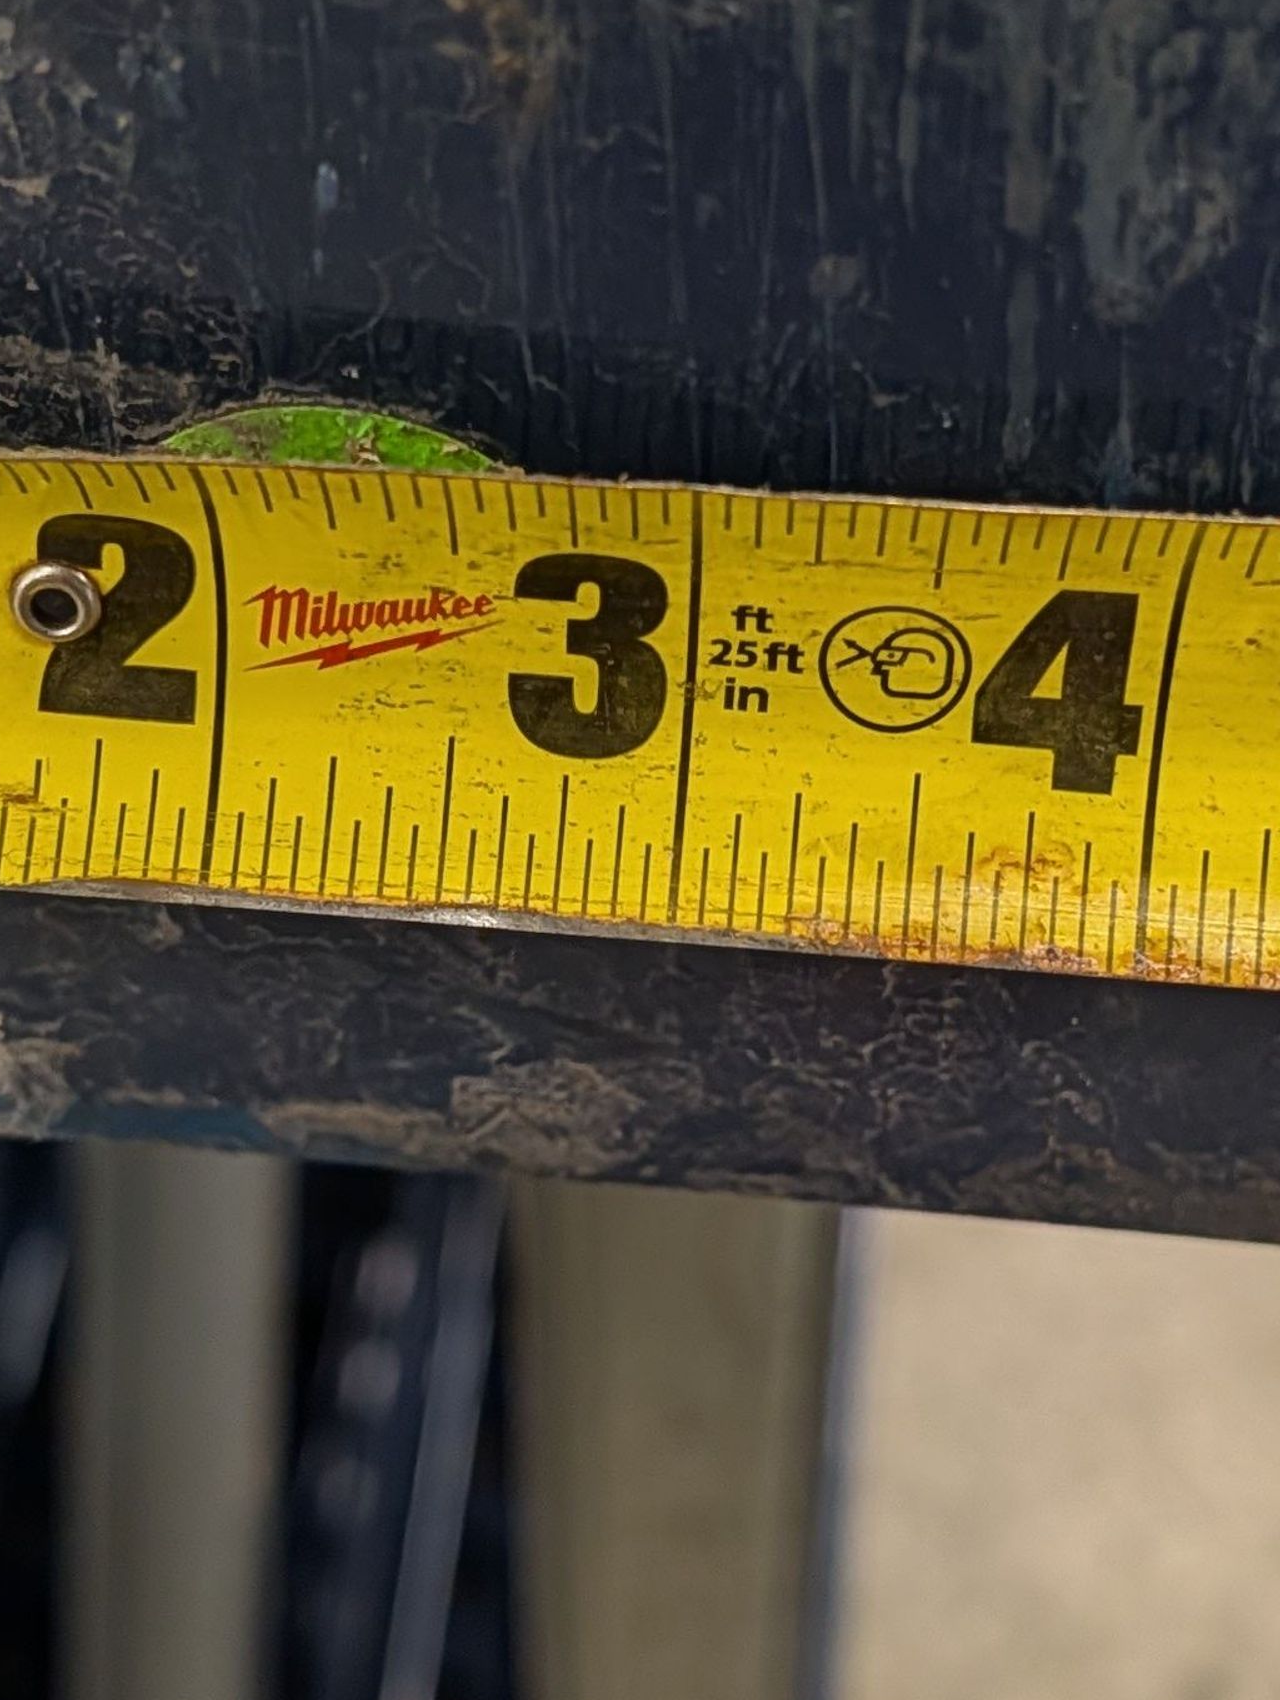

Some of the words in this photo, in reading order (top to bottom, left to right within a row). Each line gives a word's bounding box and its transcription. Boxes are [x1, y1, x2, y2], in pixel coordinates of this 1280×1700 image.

[36, 513, 198, 726] 2
[242, 584, 498, 650] Milwaukee
[507, 552, 669, 759] 3
[730, 604, 775, 634] ft
[722, 677, 770, 714] in
[970, 589, 1144, 796] 4
